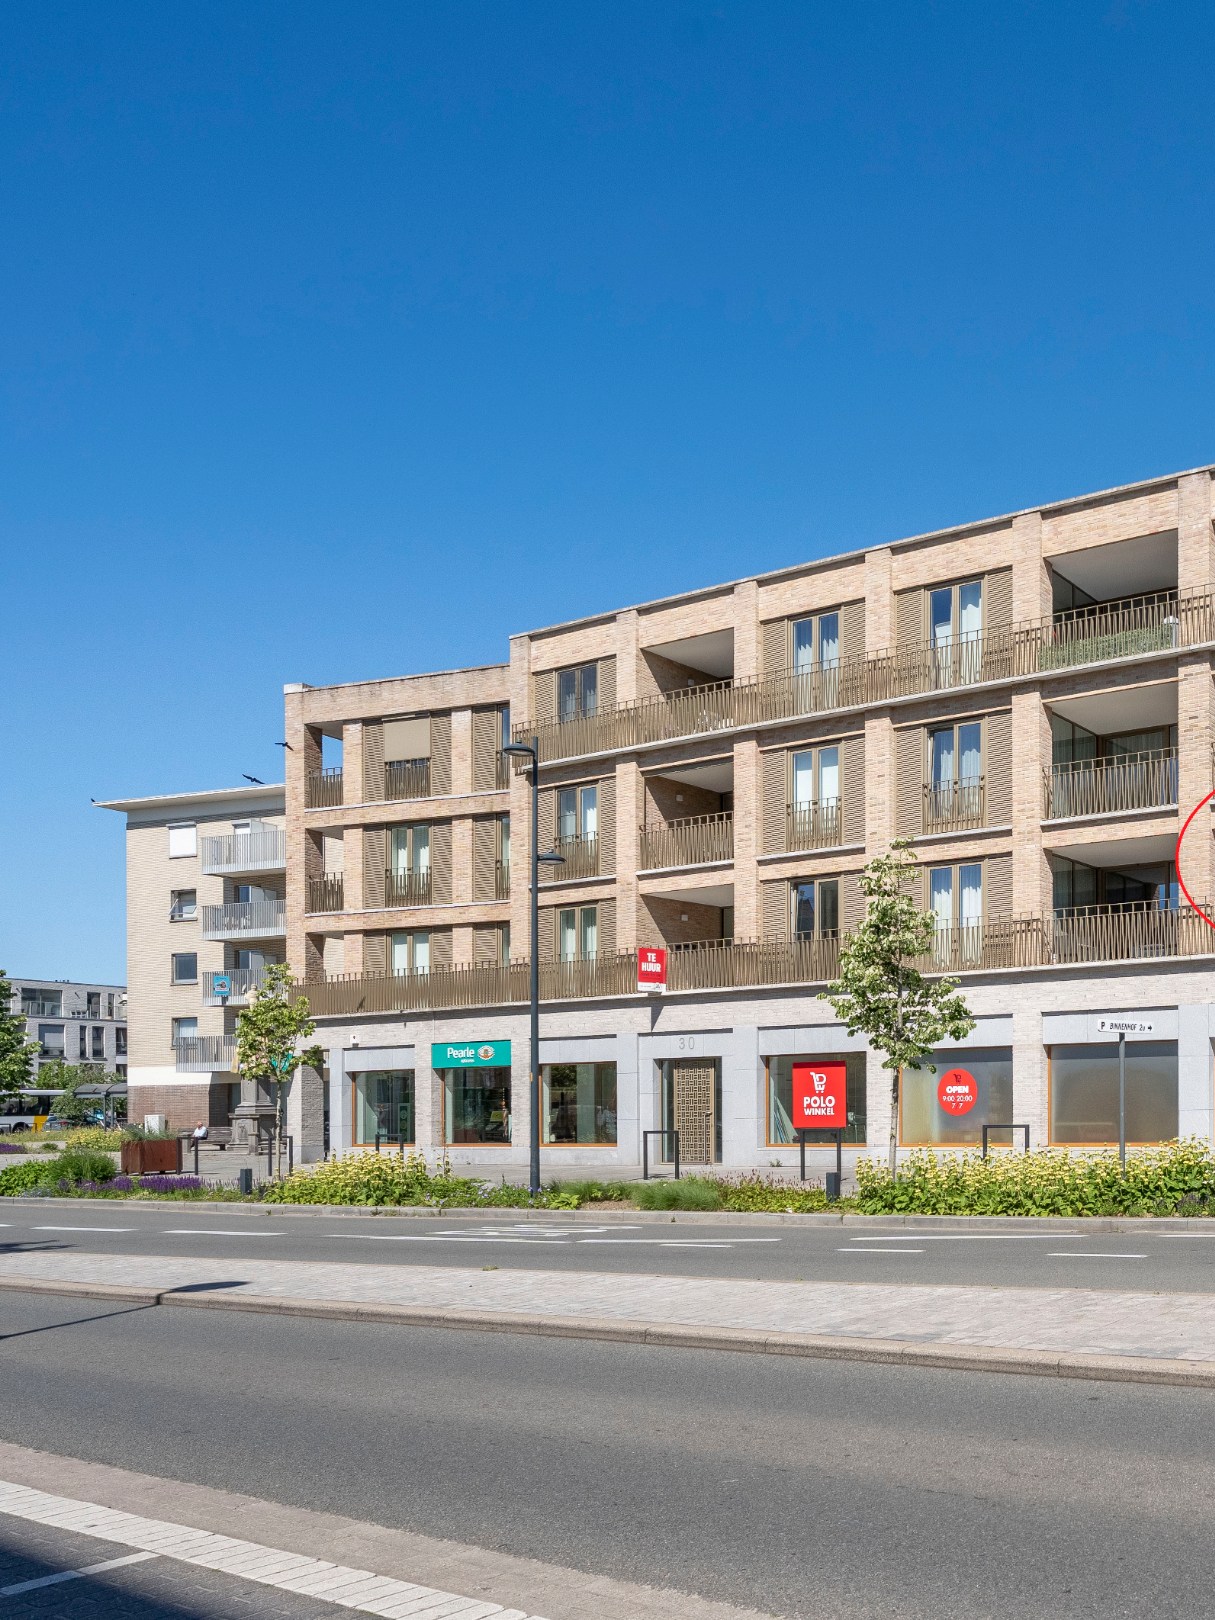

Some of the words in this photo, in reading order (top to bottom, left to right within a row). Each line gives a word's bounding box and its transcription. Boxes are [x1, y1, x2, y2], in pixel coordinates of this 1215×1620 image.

[647, 952, 657, 962] TE
[641, 962, 662, 972] HUUR
[1100, 1021, 1106, 1030] P
[678, 1036, 695, 1050] 30
[447, 1046, 475, 1058] Pearle
[945, 1085, 970, 1094] OPEN
[803, 1095, 836, 1108] POLO
[804, 1107, 835, 1116] WINKEL
